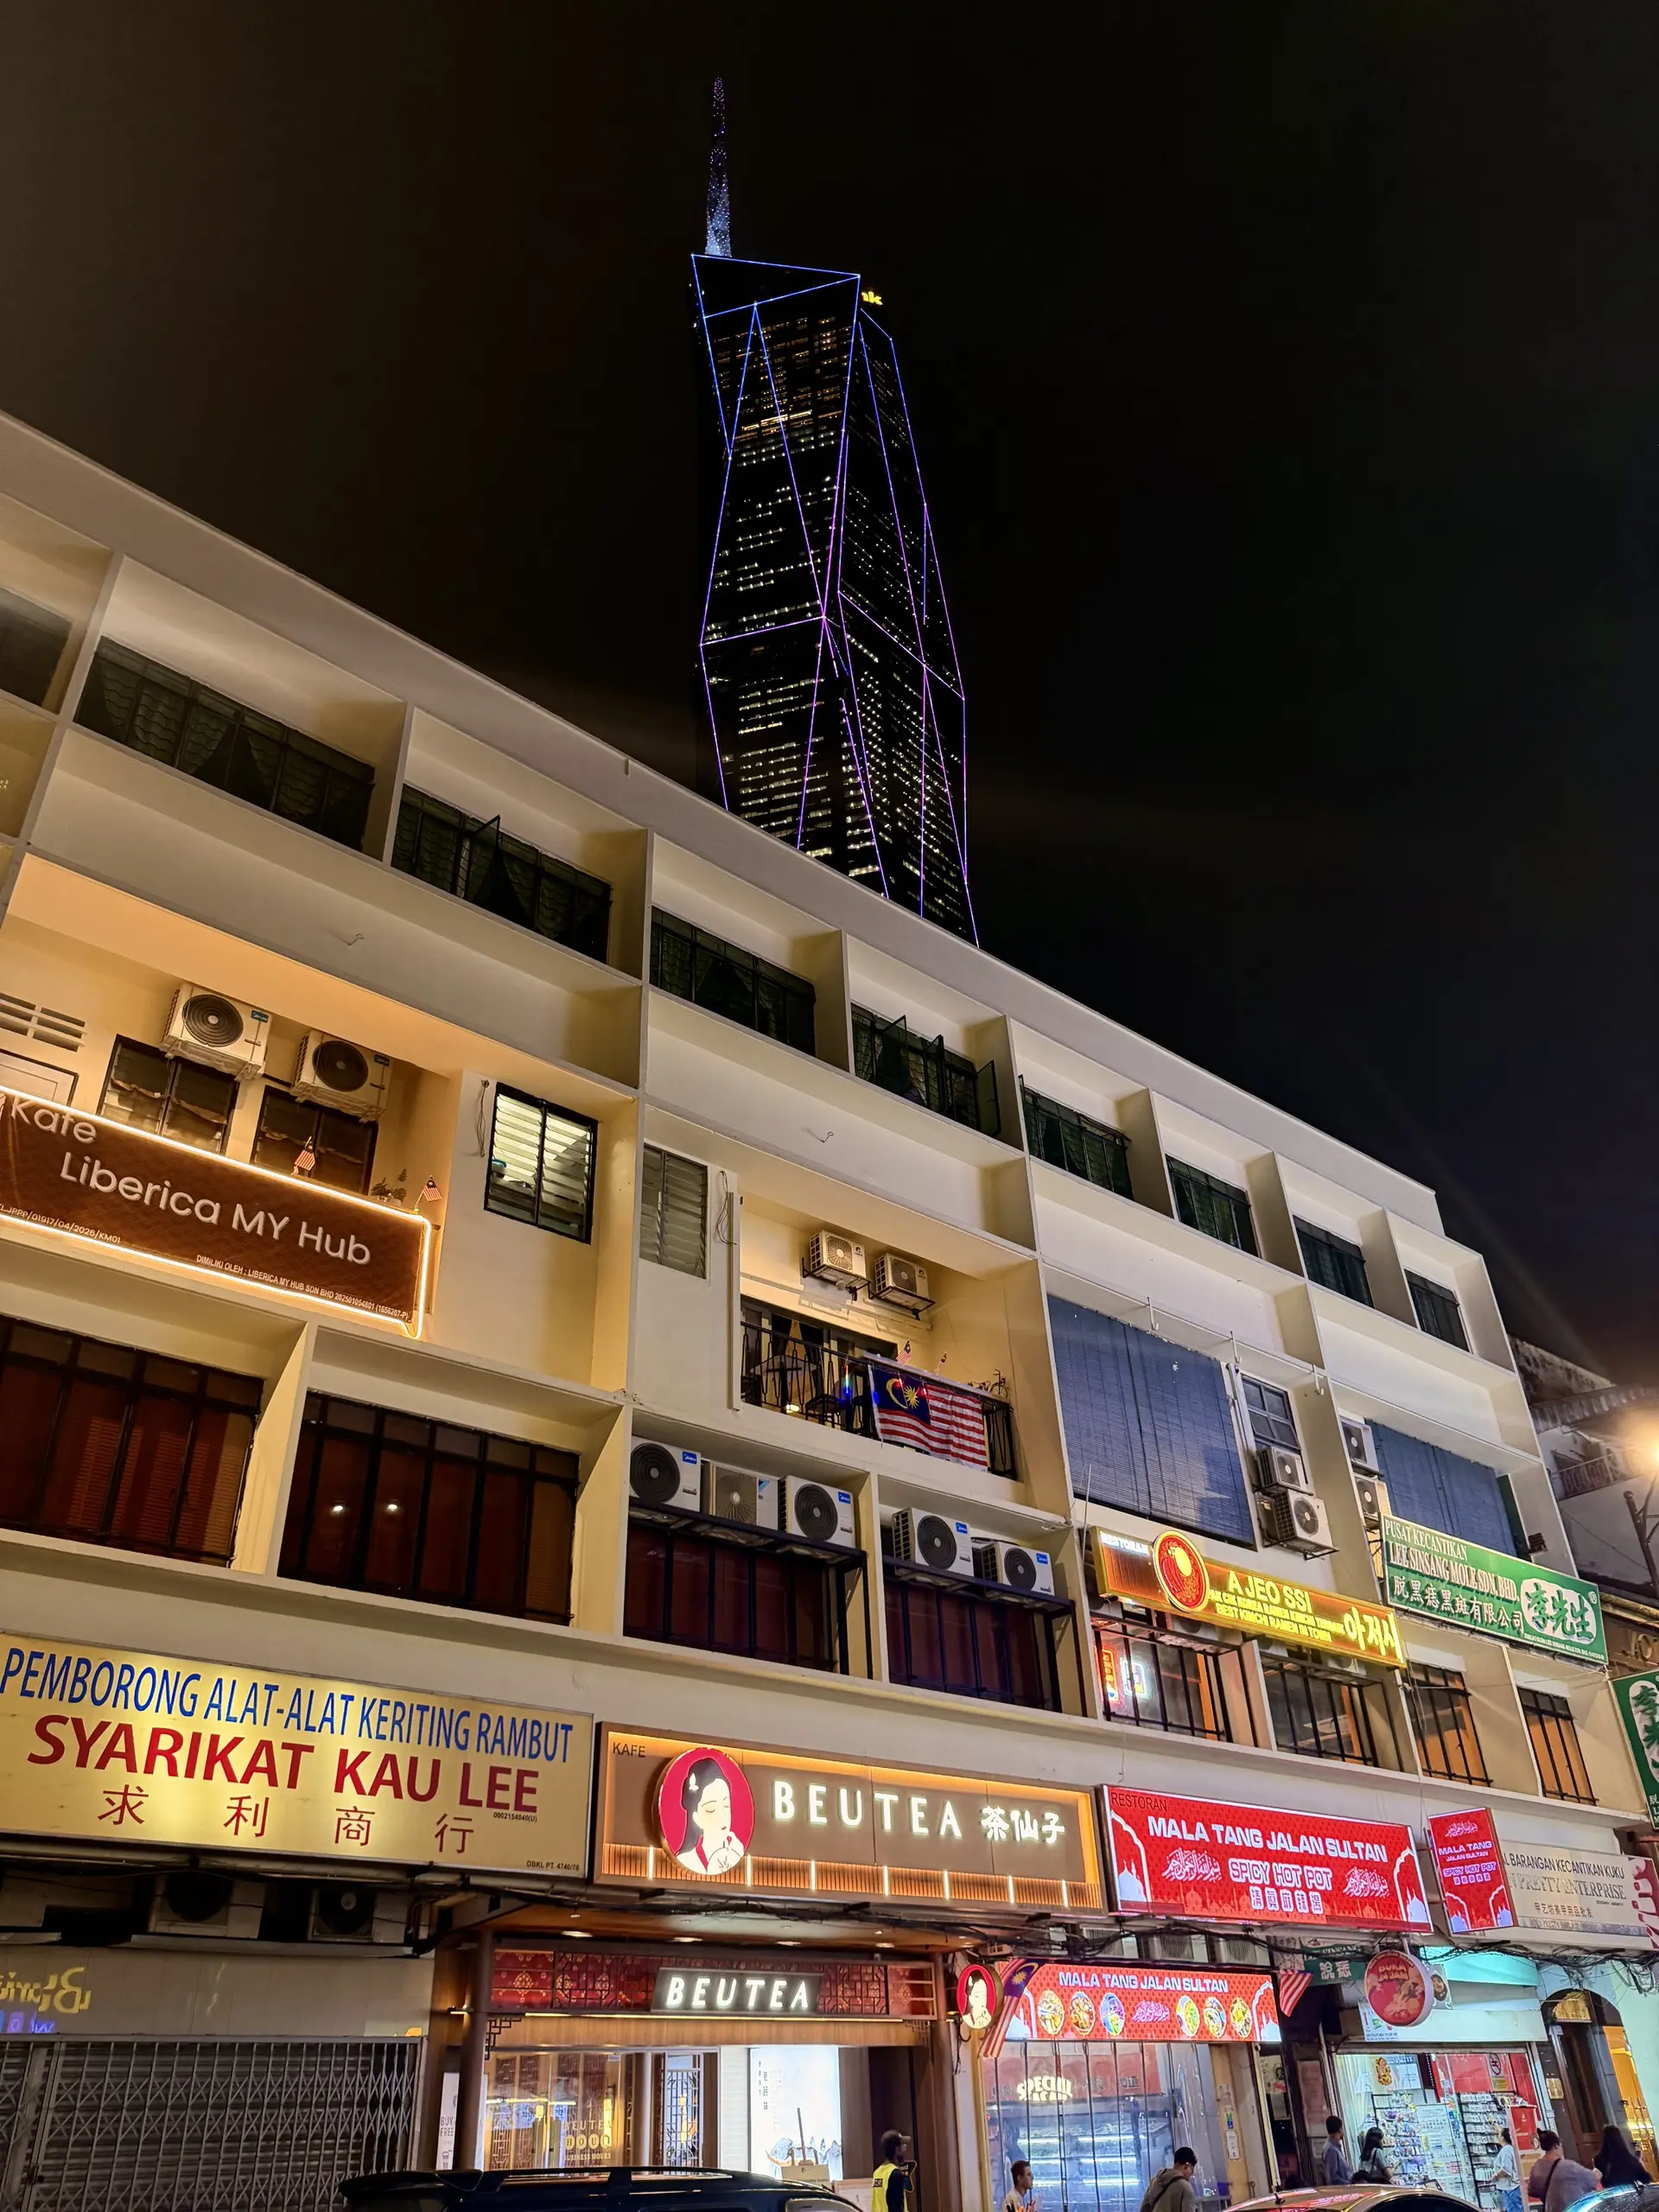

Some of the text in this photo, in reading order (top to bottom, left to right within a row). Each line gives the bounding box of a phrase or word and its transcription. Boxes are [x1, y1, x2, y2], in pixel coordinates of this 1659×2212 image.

[11, 1096, 97, 1143] Kafe
[60, 1152, 372, 1265] Liberica MY Hub
[196, 1254, 224, 1270] DIMILIKI
[225, 1262, 244, 1274] OLEH
[248, 1268, 278, 1284] LIBERICA
[278, 1276, 291, 1287] MY
[290, 1280, 305, 1291] HUB
[305, 1284, 320, 1295] SDN
[320, 1288, 334, 1299] BHD
[1385, 1519, 1467, 1561] PUSAT KECANTIKAN
[1389, 1540, 1408, 1566] LEE
[1408, 1545, 1451, 1580] SINSANG
[1449, 1558, 1478, 1587] MOLE
[1228, 1570, 1313, 1613] A JEO SSI
[1216, 1602, 1239, 1619] BEST
[1525, 1582, 1595, 1640] 李先生
[0, 1647, 574, 1764] PEMBORONG ALAT-ALAT KERITING RAMBUT
[27, 1713, 539, 1813] SYARIKAT KAU LEE
[612, 1740, 646, 1759] KAFE
[98, 1783, 474, 1855] 求利商行
[772, 1779, 1065, 1845] BEUTEA 茶仙子
[1110, 1791, 1167, 1813] RESTORAN
[1147, 1815, 1388, 1863] MALA TANG JALAN SULTAN
[1439, 1840, 1492, 1855] MALA TANG
[1443, 1861, 1497, 1877] SPICY HOT POT
[1446, 1851, 1488, 1862] JALAN SULTAN
[1510, 1853, 1555, 1872] BARANGAN
[1556, 1859, 1604, 1877] KECANTIKAN
[1604, 1865, 1624, 1879] KUKU
[1228, 1857, 1332, 1891] SPICY HOT POT
[1517, 1872, 1560, 1893] PRETTY
[1564, 1877, 1627, 1900] ENTERPRISE
[665, 1976, 810, 2009] BEUTEA
[1058, 1971, 1229, 1993] MALA TANG JALAN SULTAN
[440, 2127, 454, 2137] FREE
[441, 2116, 454, 2126] BUY
